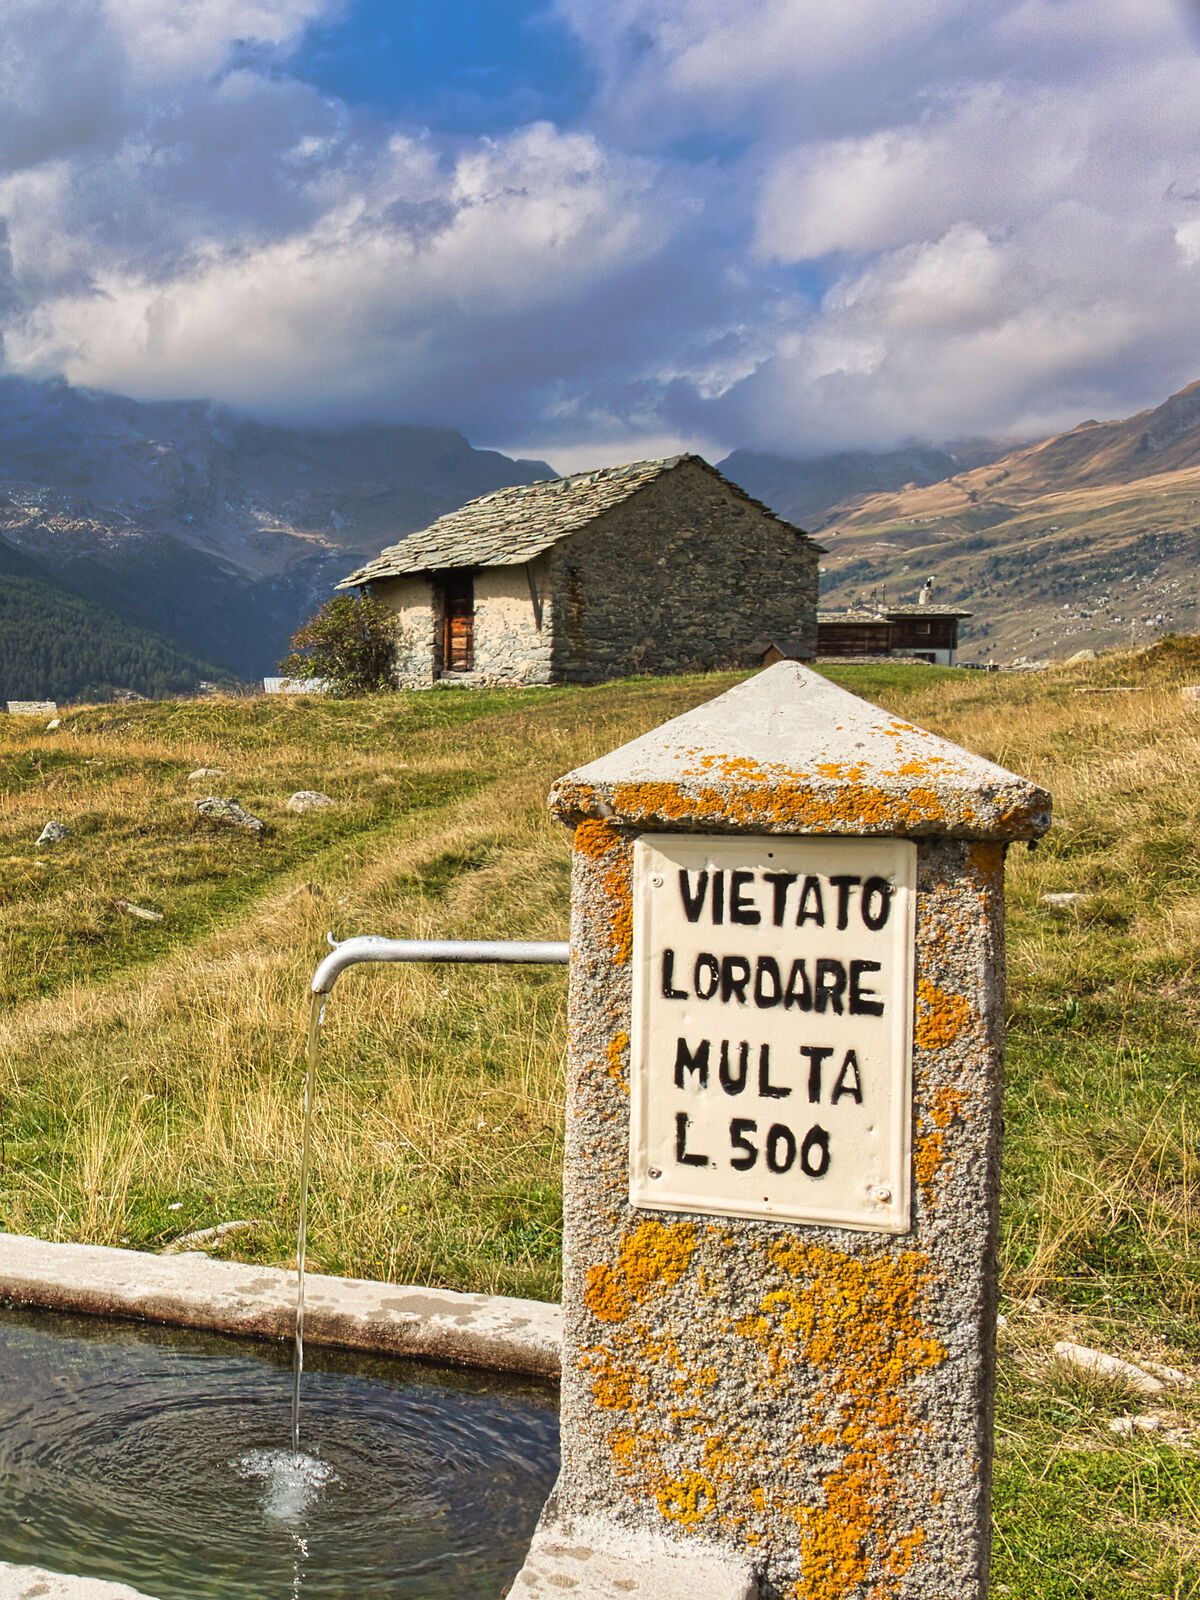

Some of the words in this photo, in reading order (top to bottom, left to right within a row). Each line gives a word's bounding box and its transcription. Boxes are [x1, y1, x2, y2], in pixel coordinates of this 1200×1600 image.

[679, 870, 892, 930] VIETATO
[662, 949, 884, 1016] LORDARE
[675, 1038, 863, 1104] MULTA
